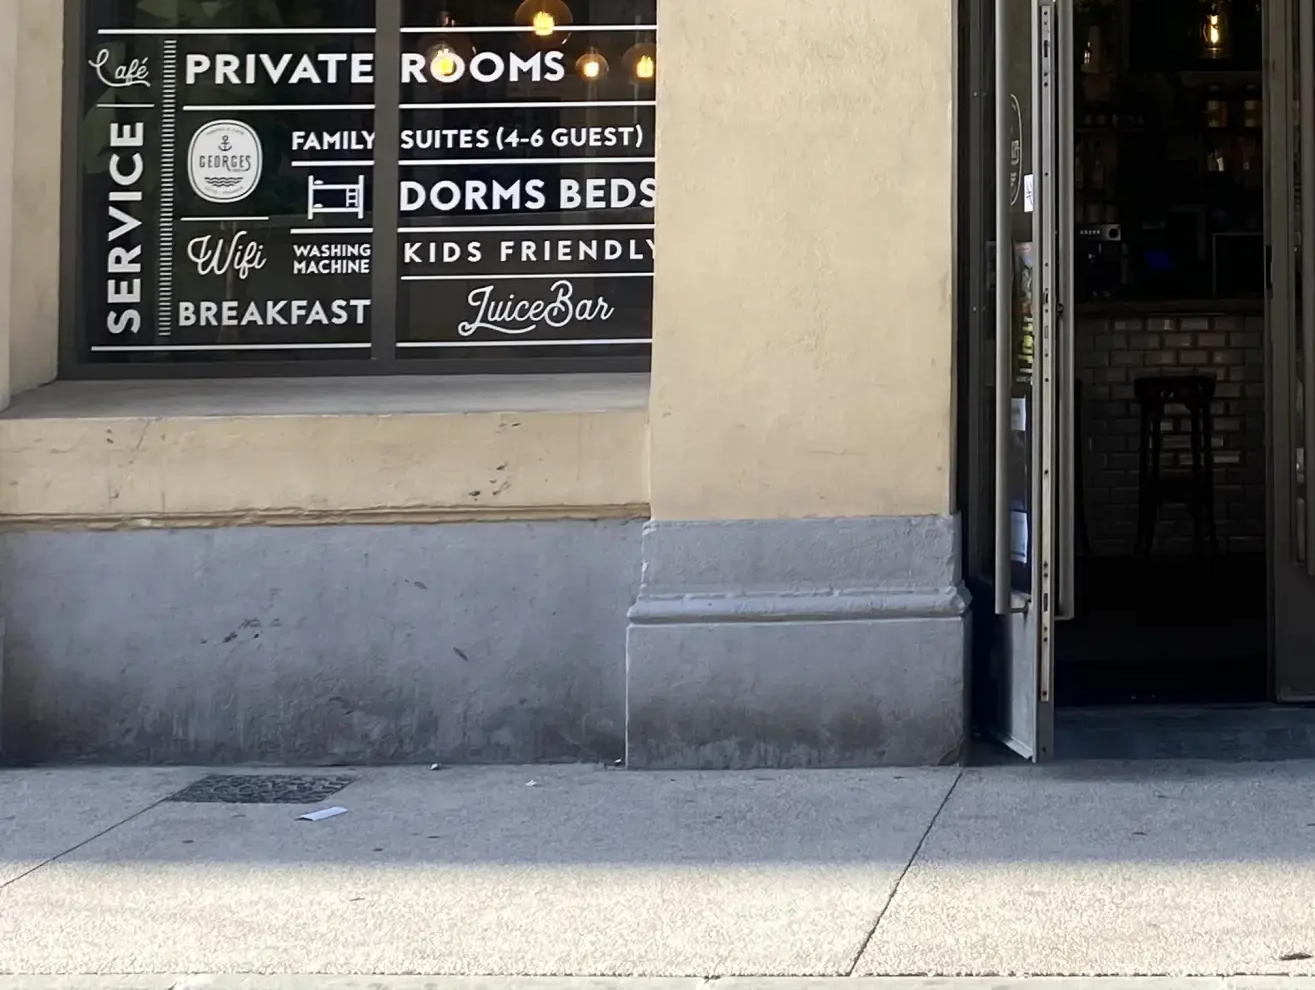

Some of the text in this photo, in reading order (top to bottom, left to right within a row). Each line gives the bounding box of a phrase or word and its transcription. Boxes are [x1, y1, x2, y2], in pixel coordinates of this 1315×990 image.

[88, 48, 151, 87] Café
[185, 50, 565, 85] PRIVATE ROOMS
[291, 124, 643, 151] FAMILY SUITES (4-6 GUEST)
[199, 154, 252, 172] GEORGES
[400, 177, 655, 211] DORMS BEDS
[107, 122, 144, 334] SERVICE
[187, 230, 267, 280] Wifi
[293, 243, 371, 257] WASHING
[404, 241, 482, 263] KIDS
[293, 259, 370, 274] MACHINE
[178, 299, 371, 326] BREAKFAST
